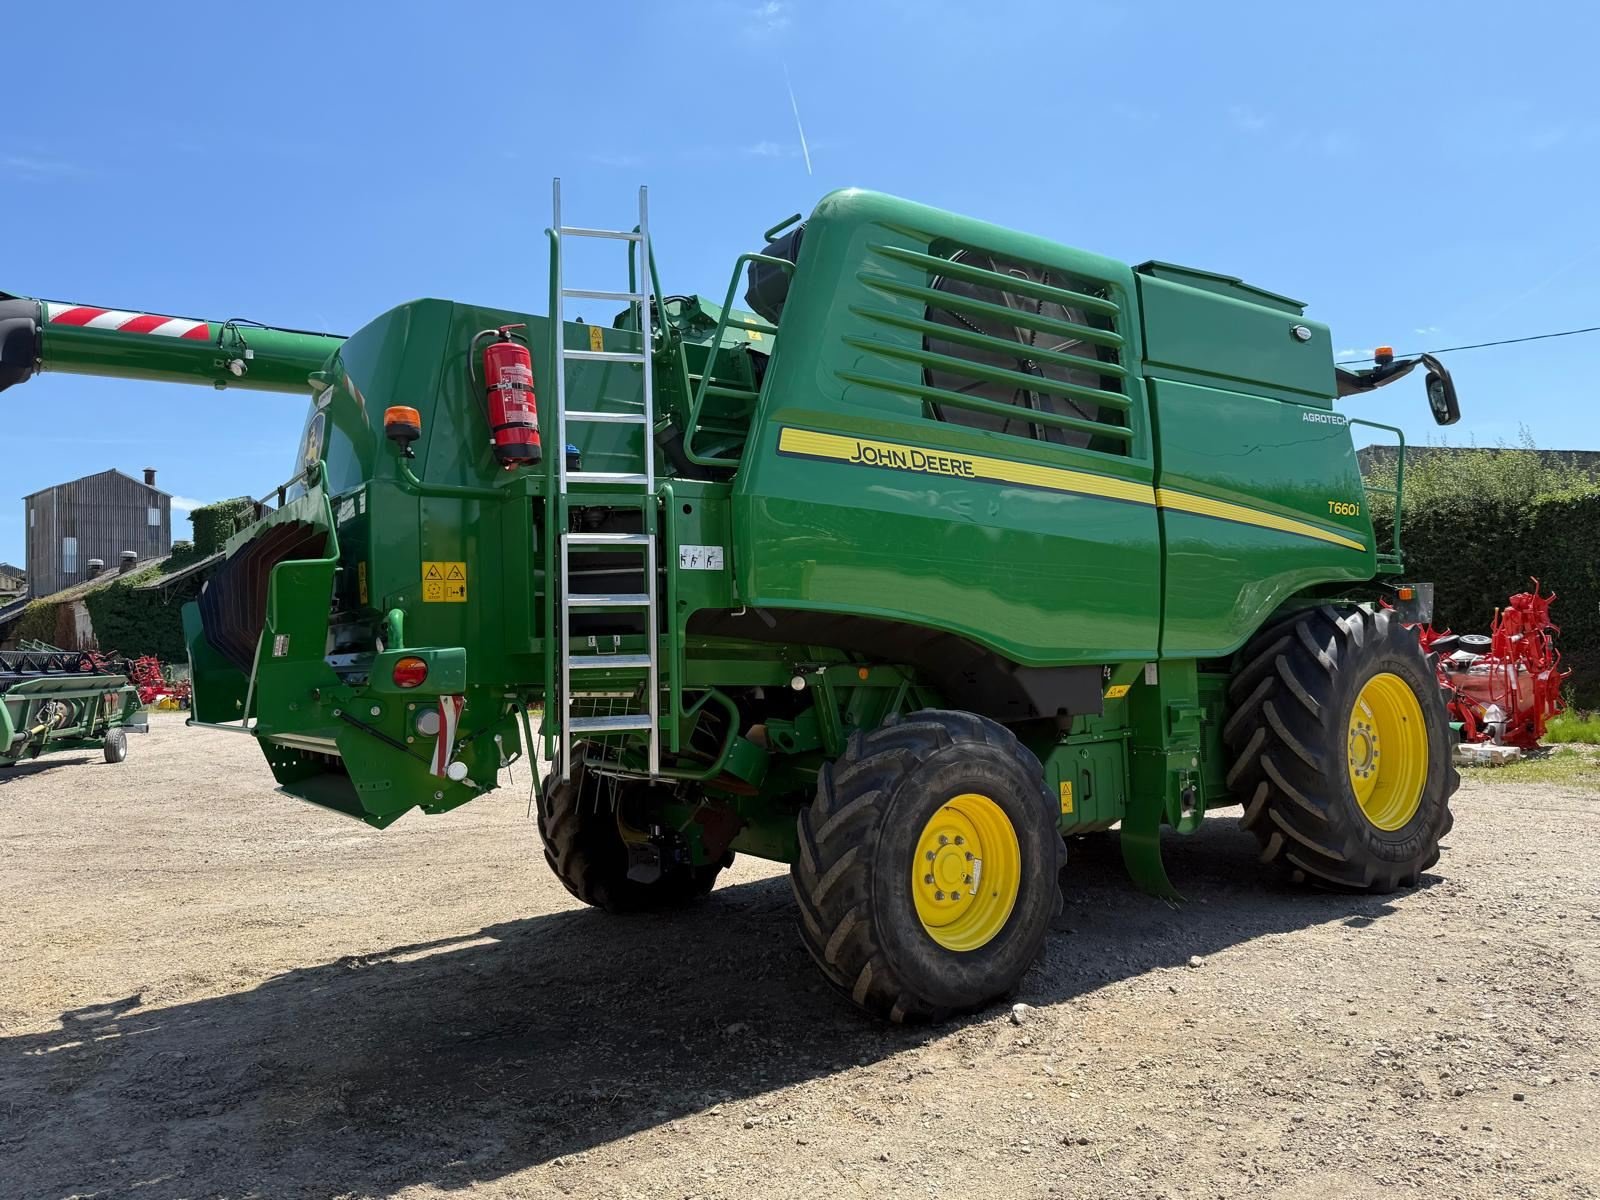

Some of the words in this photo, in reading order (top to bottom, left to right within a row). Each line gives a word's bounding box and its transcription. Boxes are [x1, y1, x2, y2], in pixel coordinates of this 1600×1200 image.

[1302, 412, 1349, 425] AGROTECH
[851, 442, 907, 467] JOHN
[910, 450, 975, 475] DEERE
[1328, 501, 1359, 516] T660i
